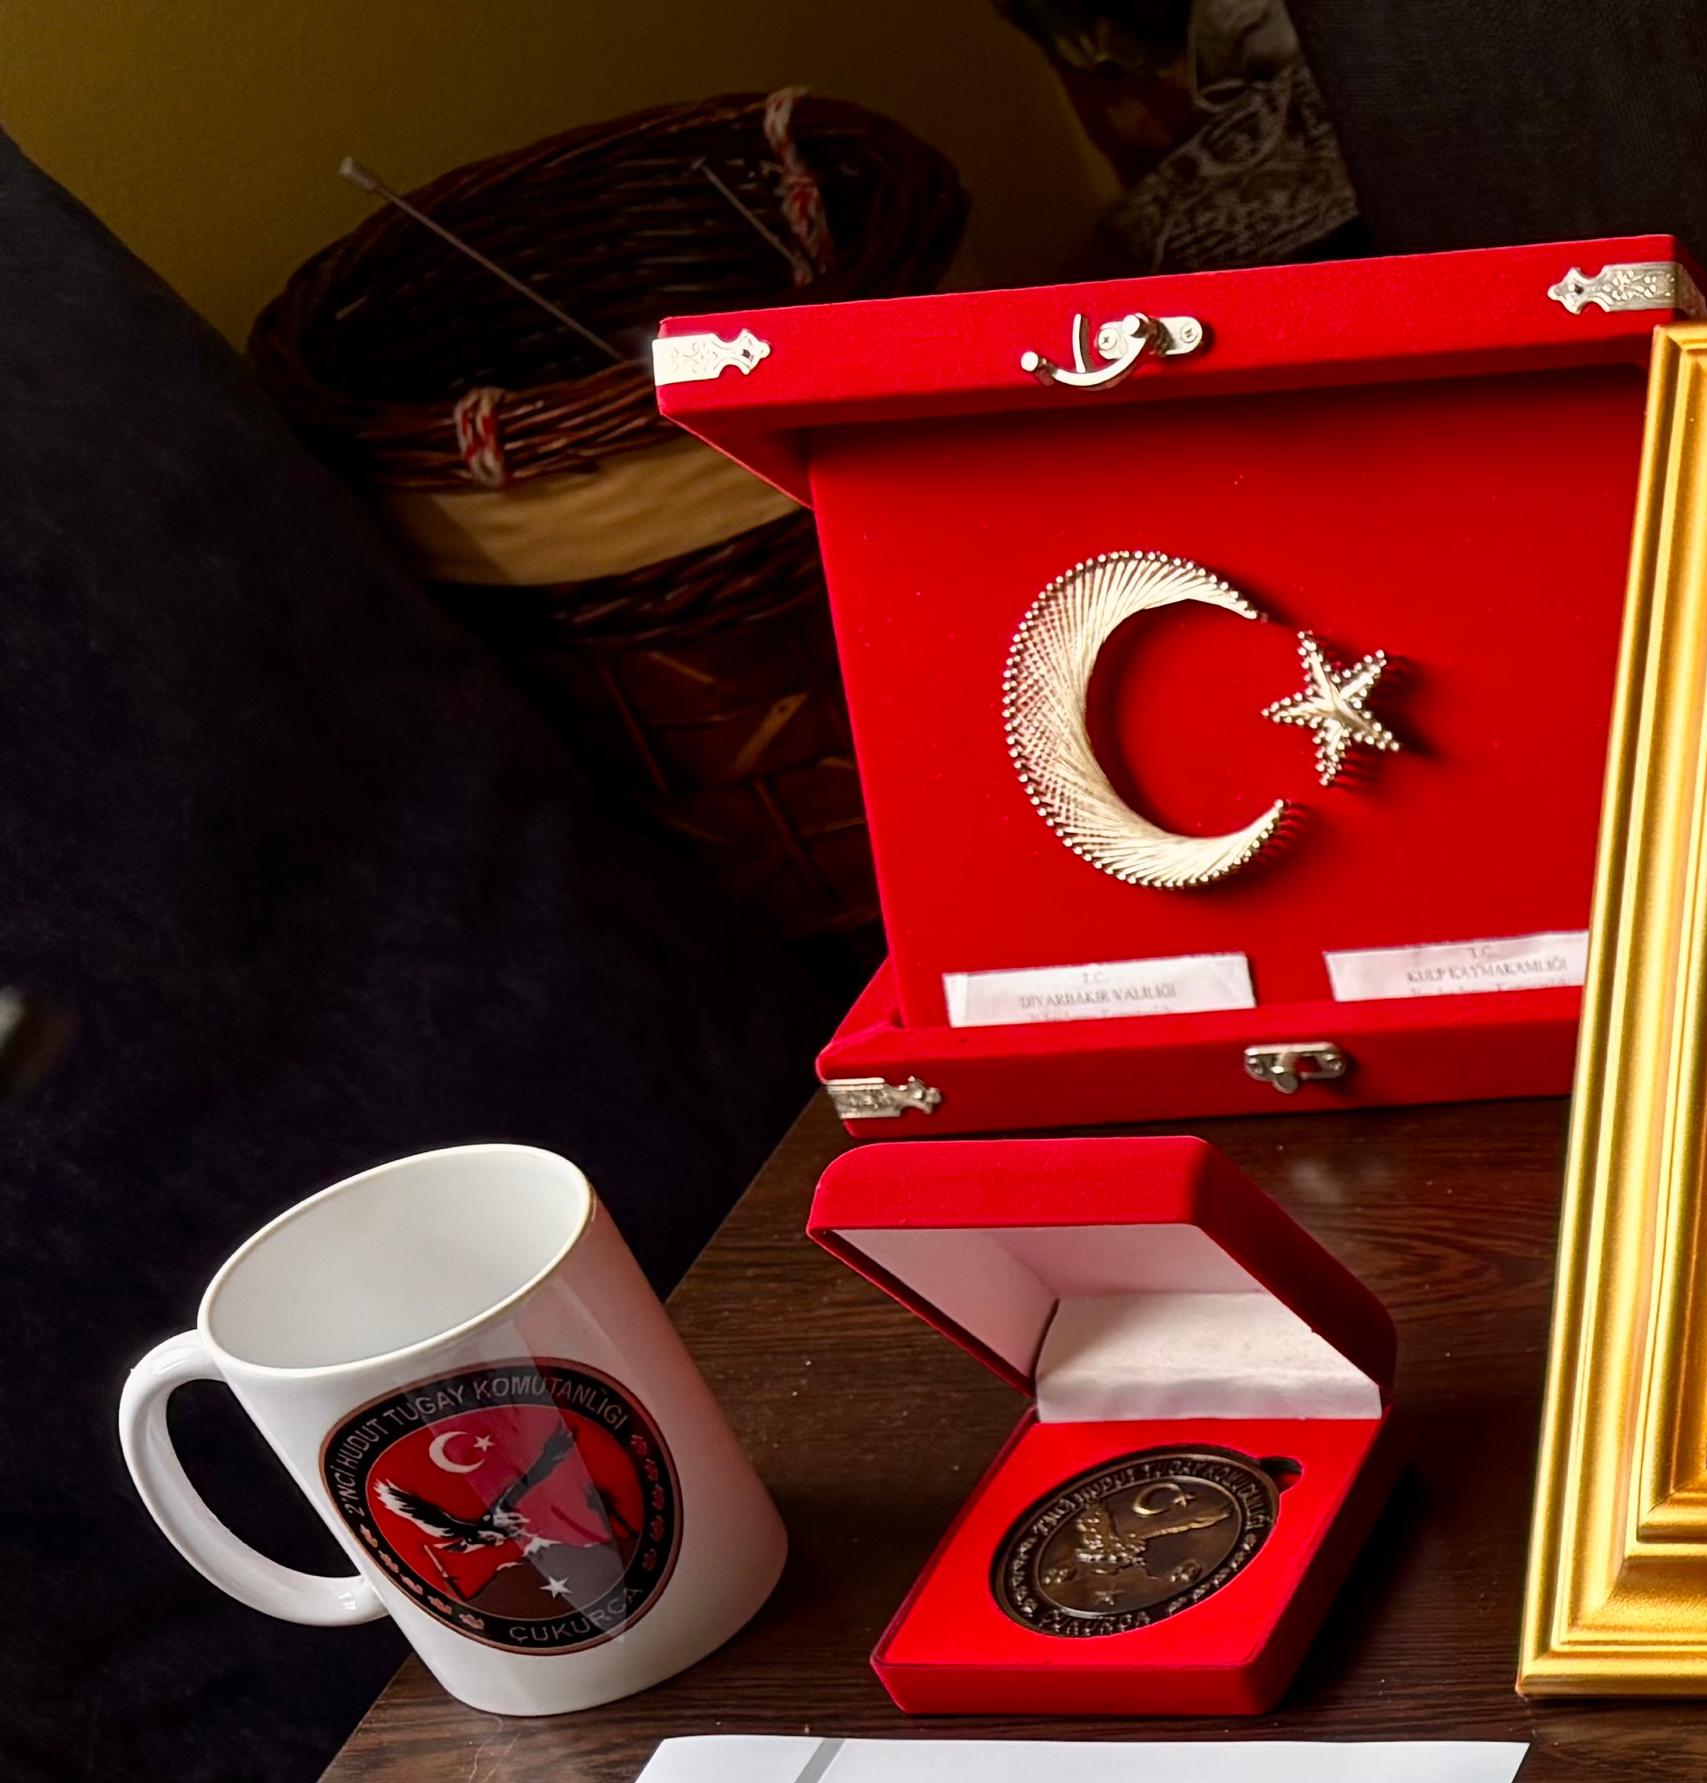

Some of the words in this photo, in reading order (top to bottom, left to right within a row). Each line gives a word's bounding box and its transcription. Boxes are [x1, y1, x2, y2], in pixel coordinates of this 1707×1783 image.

[340, 1418, 389, 1467] HUDUT
[383, 1385, 464, 1428] TUGAY
[508, 1587, 644, 1643] ÇUKURCA
